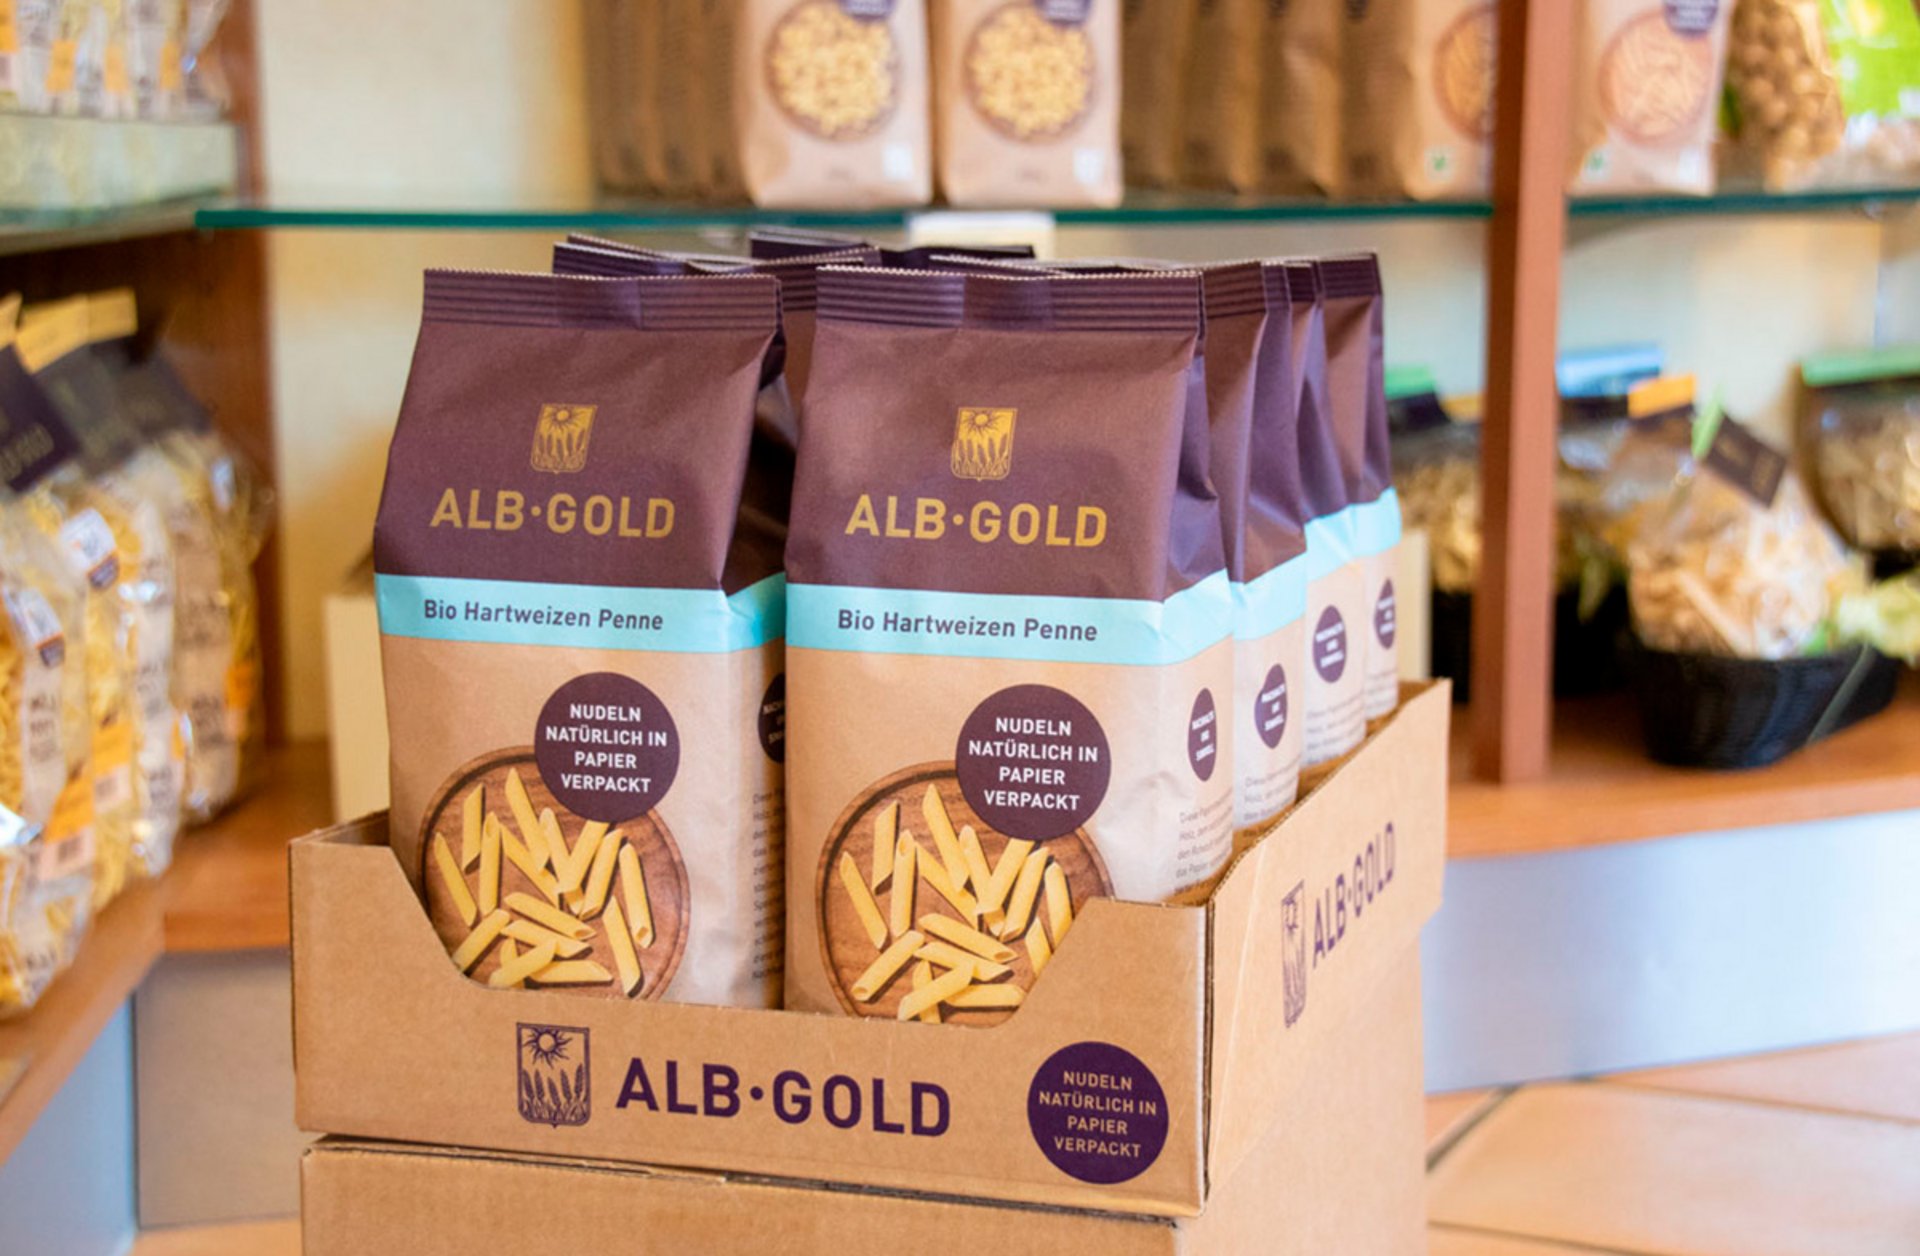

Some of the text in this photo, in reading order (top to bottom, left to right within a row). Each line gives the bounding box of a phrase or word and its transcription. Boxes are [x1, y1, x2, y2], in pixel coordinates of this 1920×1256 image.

[424, 599, 663, 630] Bio Hartweizen Penne
[838, 609, 1098, 641] Bio Hartweizen Penne
[570, 703, 641, 722] NUDELN
[546, 724, 667, 747] NATÜRLICH IN
[995, 717, 1072, 736] NUDELN
[574, 751, 637, 769] PAPIER
[968, 739, 1098, 762] NATÜRLICH IN
[560, 773, 651, 793] VERPACKT
[998, 766, 1065, 785] PAPIER
[984, 790, 1080, 810] VERPACKT
[1063, 1071, 1132, 1091] NUDELN
[1039, 1091, 1156, 1116] NATÜRLICH IN
[1067, 1115, 1128, 1136] PAPIER
[1054, 1136, 1141, 1158] VERPACKT
